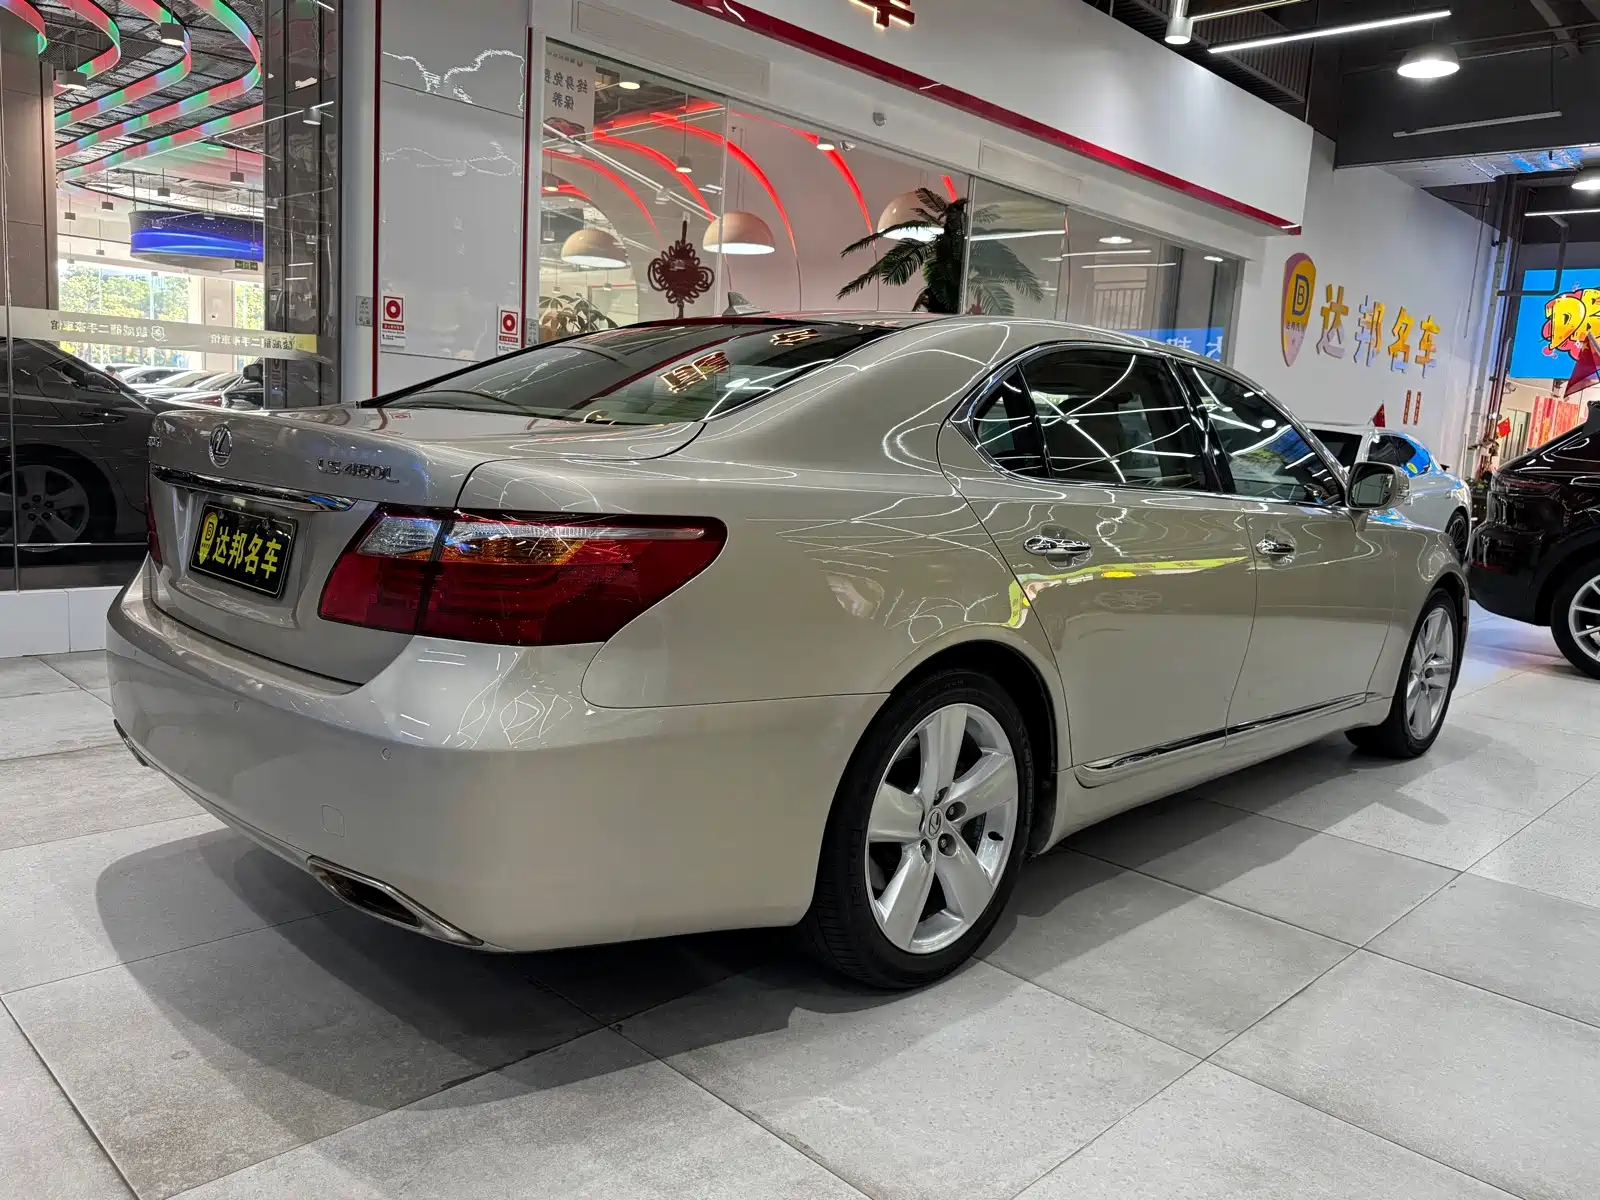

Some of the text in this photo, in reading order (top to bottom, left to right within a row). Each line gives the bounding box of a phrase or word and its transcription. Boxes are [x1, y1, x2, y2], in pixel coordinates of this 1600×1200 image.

[1316, 284, 1440, 379] 达邦名车
[212, 526, 282, 580] 达邦名车
